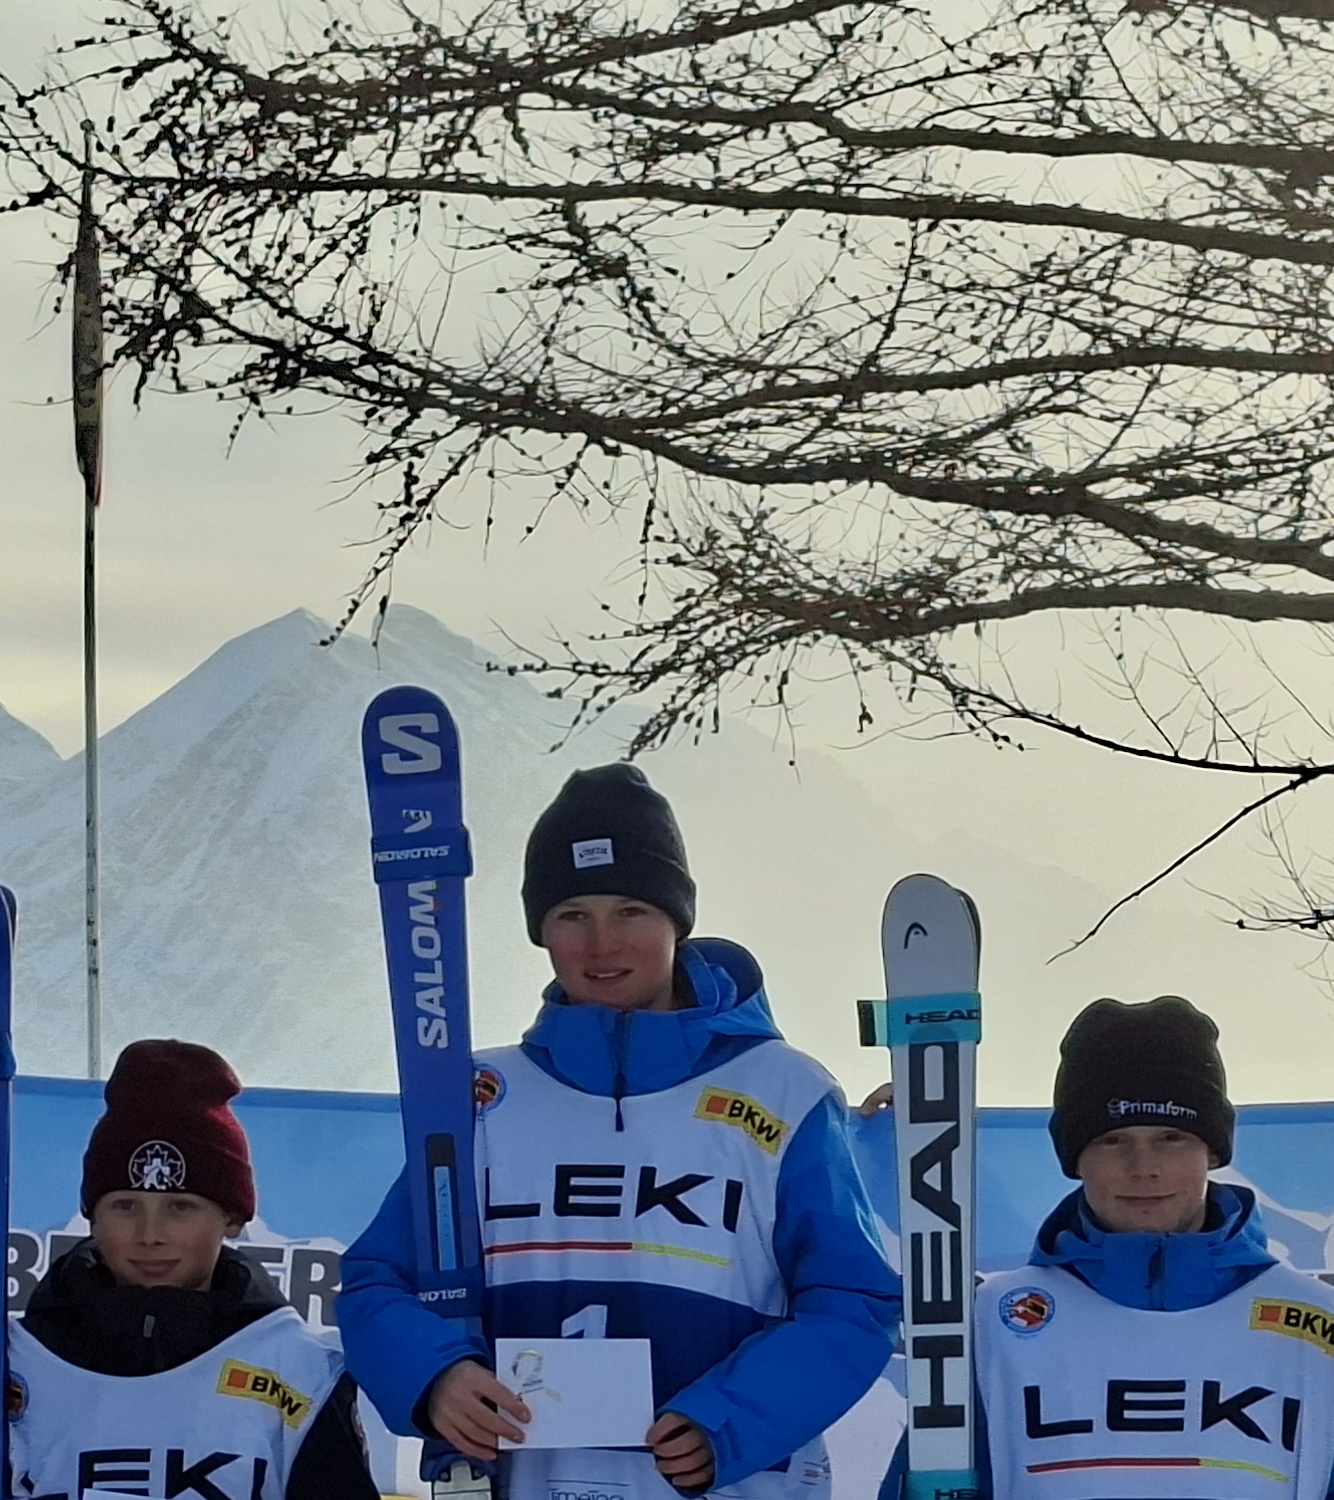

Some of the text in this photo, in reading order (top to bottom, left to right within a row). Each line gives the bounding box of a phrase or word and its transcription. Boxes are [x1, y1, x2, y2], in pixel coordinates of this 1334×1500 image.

[402, 809, 449, 1049] SALOMN
[906, 1010, 979, 1024] HEAD
[728, 1097, 783, 1144] BKW
[485, 1164, 742, 1233] LEKI
[908, 1041, 966, 1428] HEAD
[250, 1375, 302, 1417] BKW
[1023, 1379, 1301, 1452] LEKI
